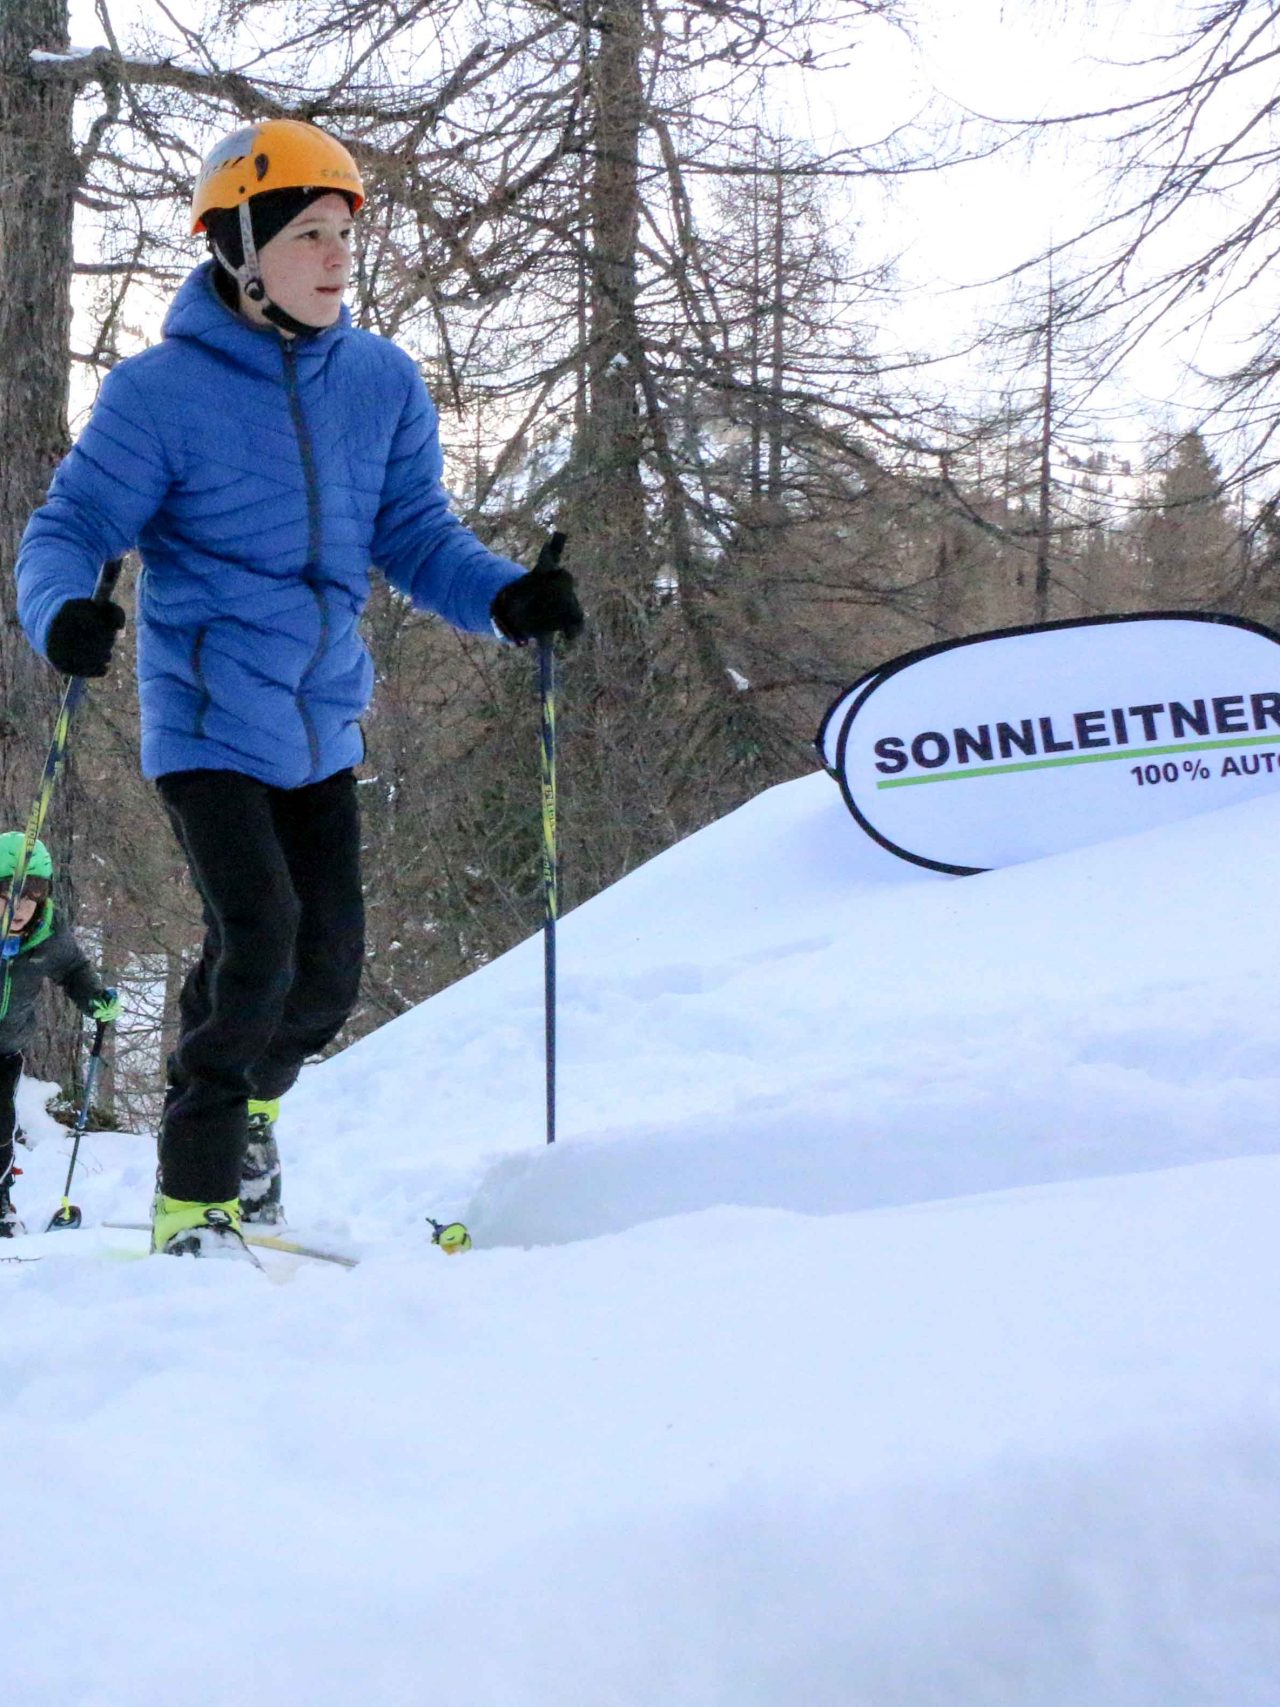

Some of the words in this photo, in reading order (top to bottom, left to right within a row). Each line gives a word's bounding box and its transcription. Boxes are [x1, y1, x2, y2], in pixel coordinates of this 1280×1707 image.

[874, 692, 1280, 774] SONNLEITNER
[1131, 759, 1210, 786] 100%
[1220, 752, 1280, 778] AUT
